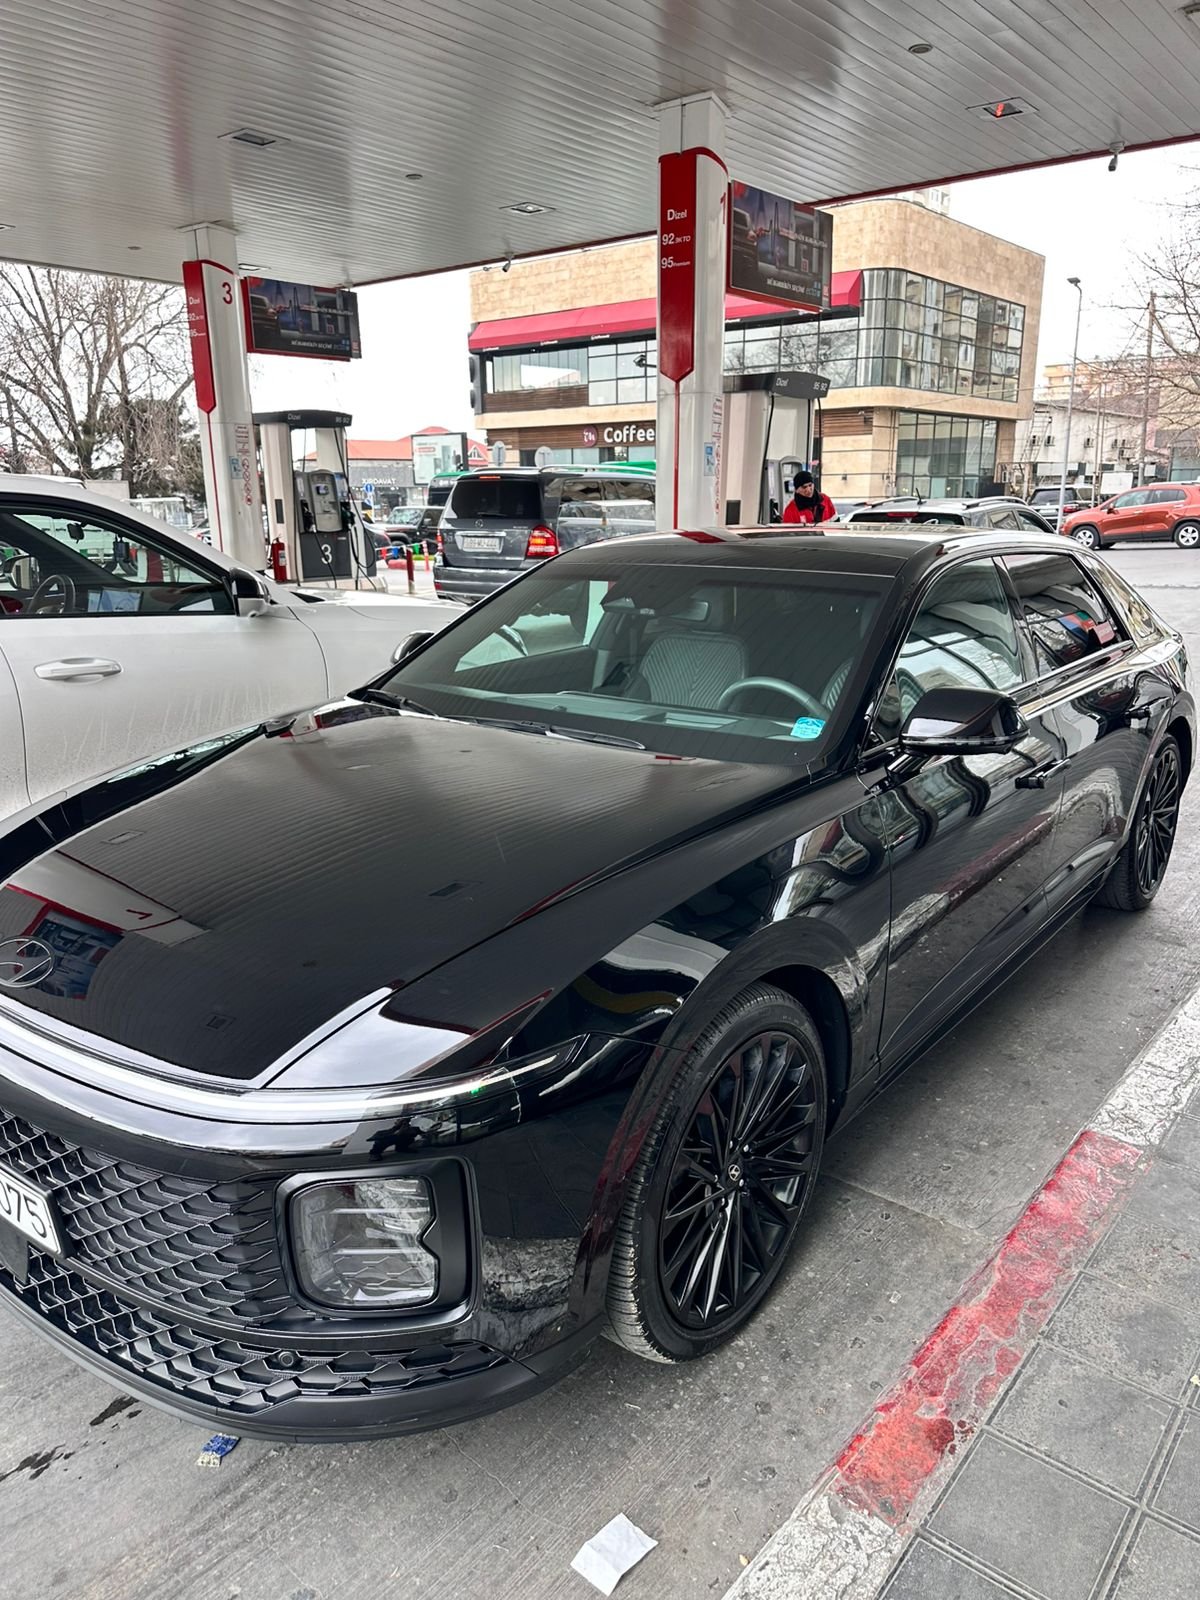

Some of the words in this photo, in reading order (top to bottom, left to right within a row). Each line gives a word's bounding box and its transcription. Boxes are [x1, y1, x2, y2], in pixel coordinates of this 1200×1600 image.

[667, 209, 687, 221] Dizel
[662, 233, 675, 246] 92
[661, 256, 674, 269] 95
[222, 282, 233, 305] 3
[603, 424, 656, 443] Coffee
[321, 544, 333, 564] 3
